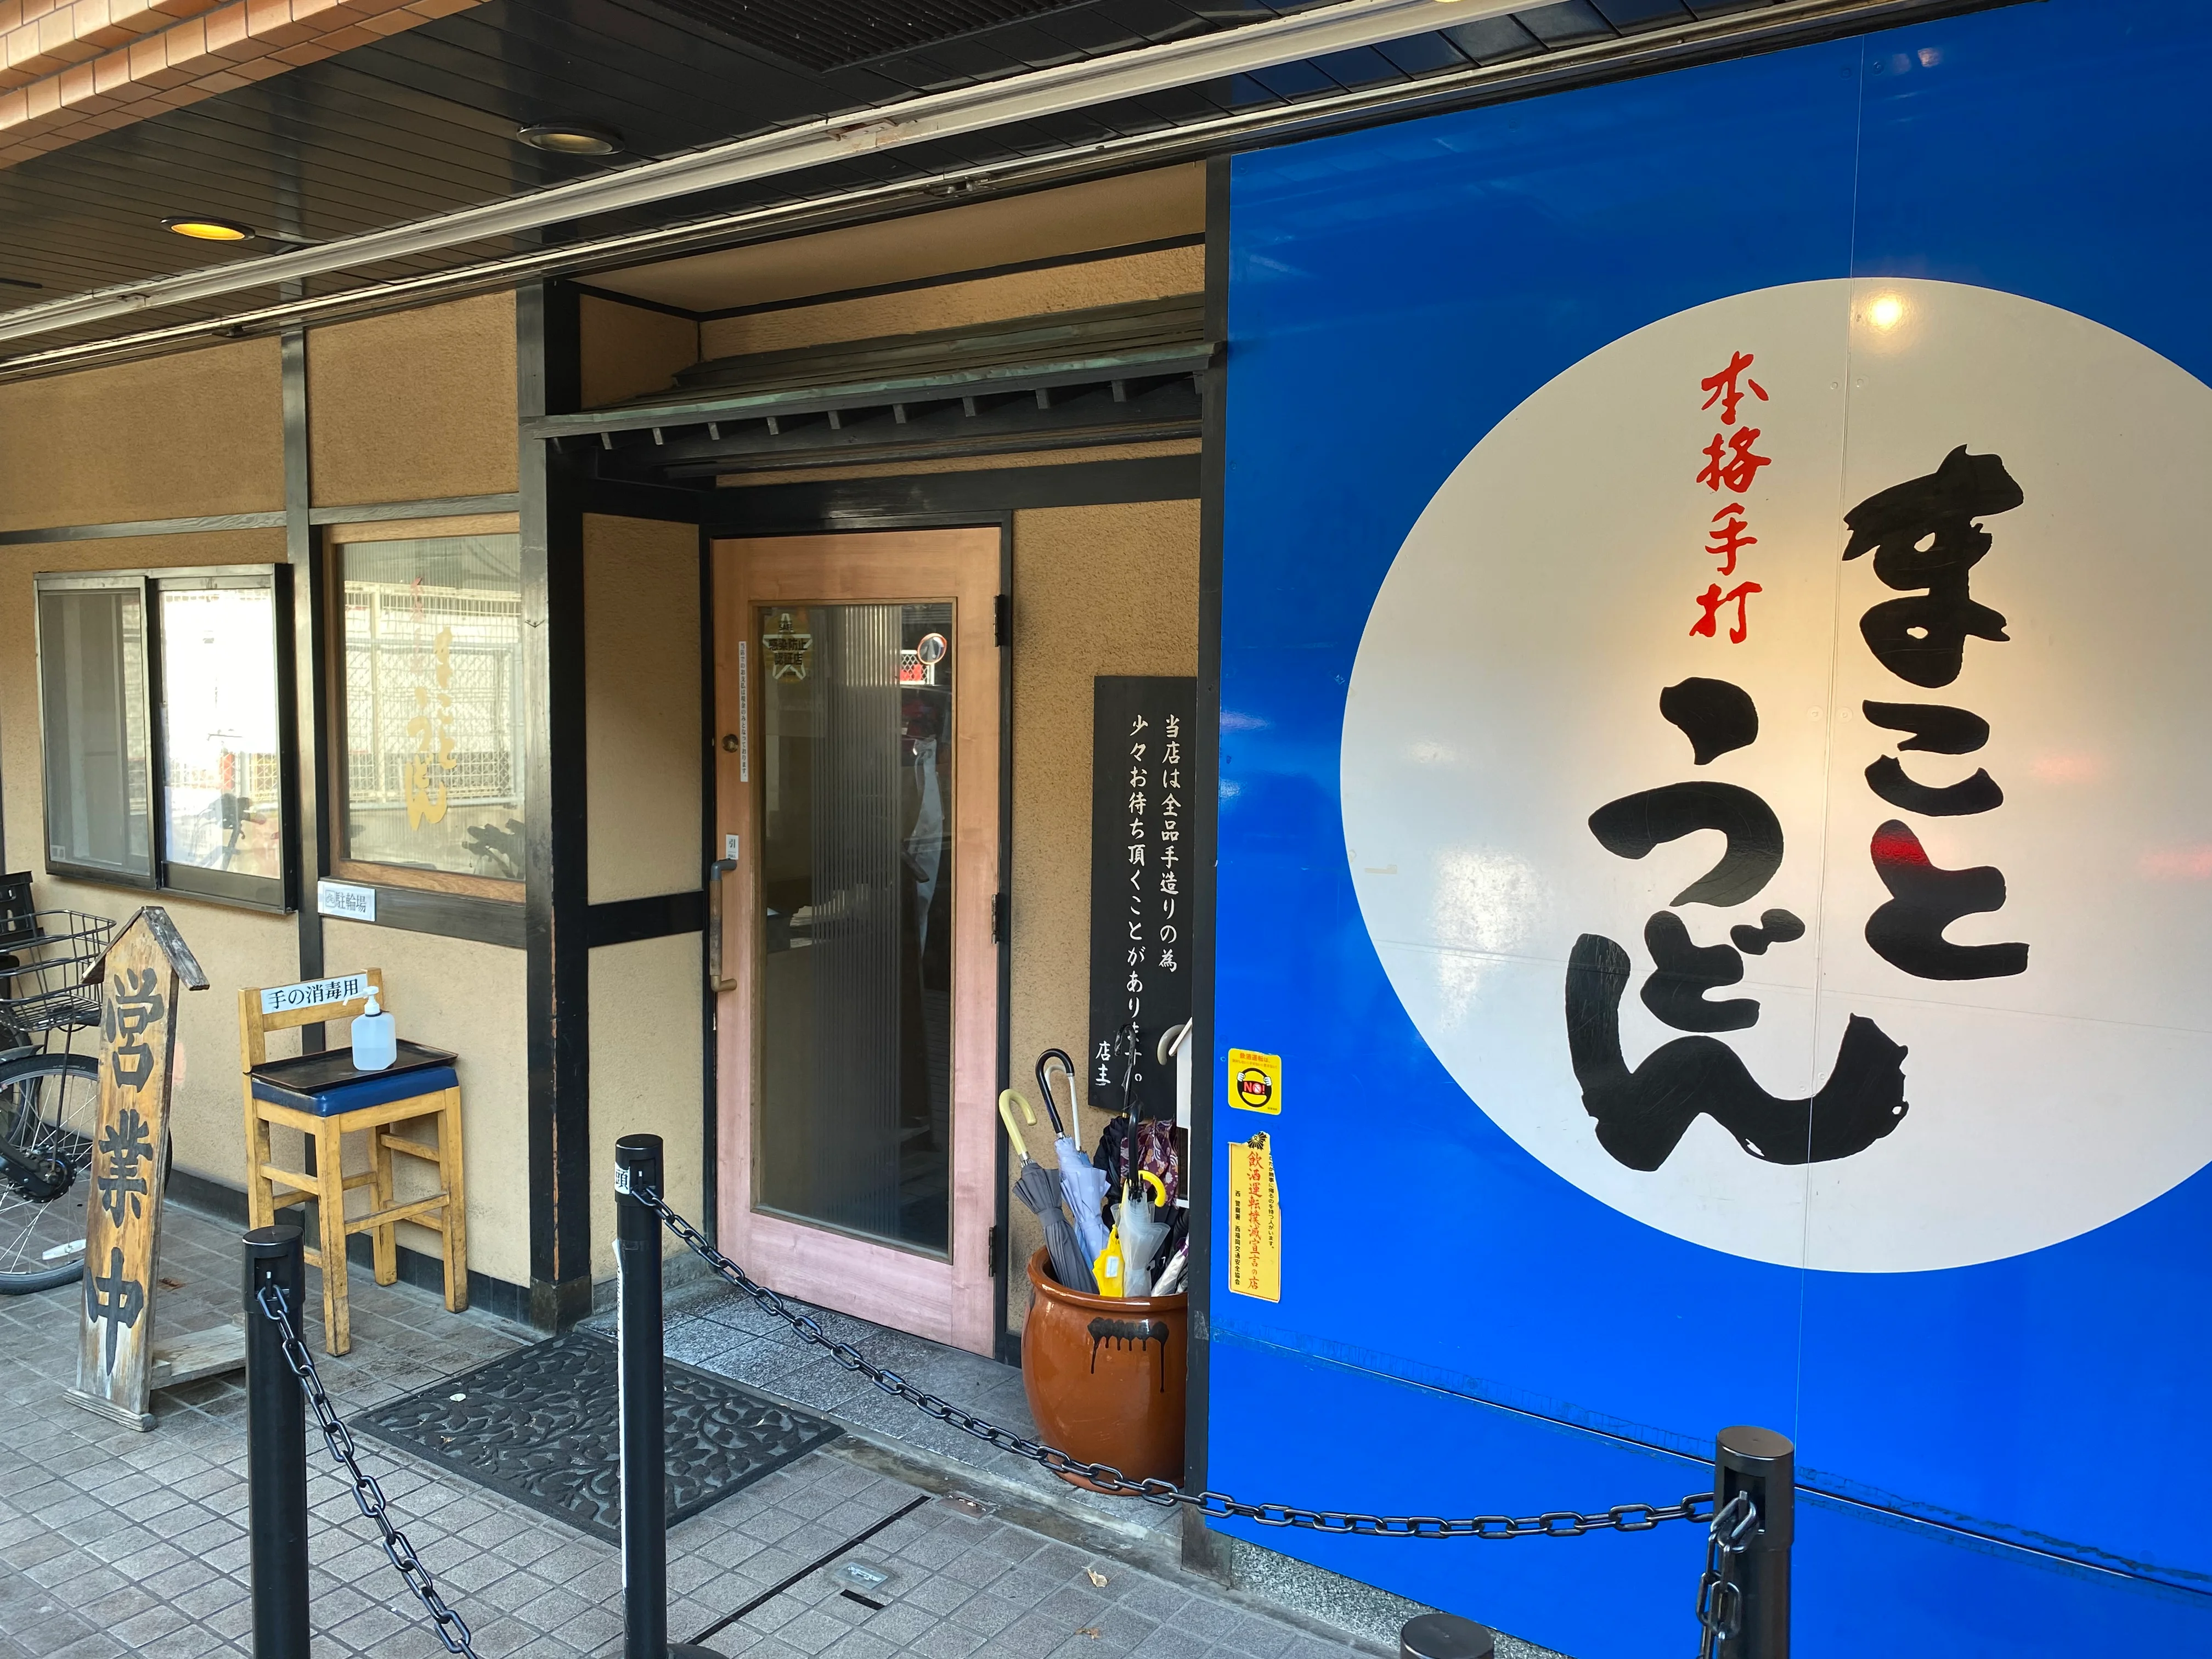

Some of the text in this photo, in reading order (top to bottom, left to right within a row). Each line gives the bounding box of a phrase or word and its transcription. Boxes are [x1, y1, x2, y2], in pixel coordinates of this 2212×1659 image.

[1690, 351, 1771, 644] 本格手打
[768, 638, 808, 651] 感染防止
[774, 653, 803, 665] 認証店
[1842, 444, 2029, 981] まこと
[336, 891, 366, 913] 駐輪場
[1159, 714, 1181, 972] 当店は全品手造りの為
[267, 978, 358, 1009] 手の消毒用
[1566, 677, 1909, 1172] うどん
[1096, 1040, 1111, 1086] 店主
[87, 967, 165, 1375] 営業中
